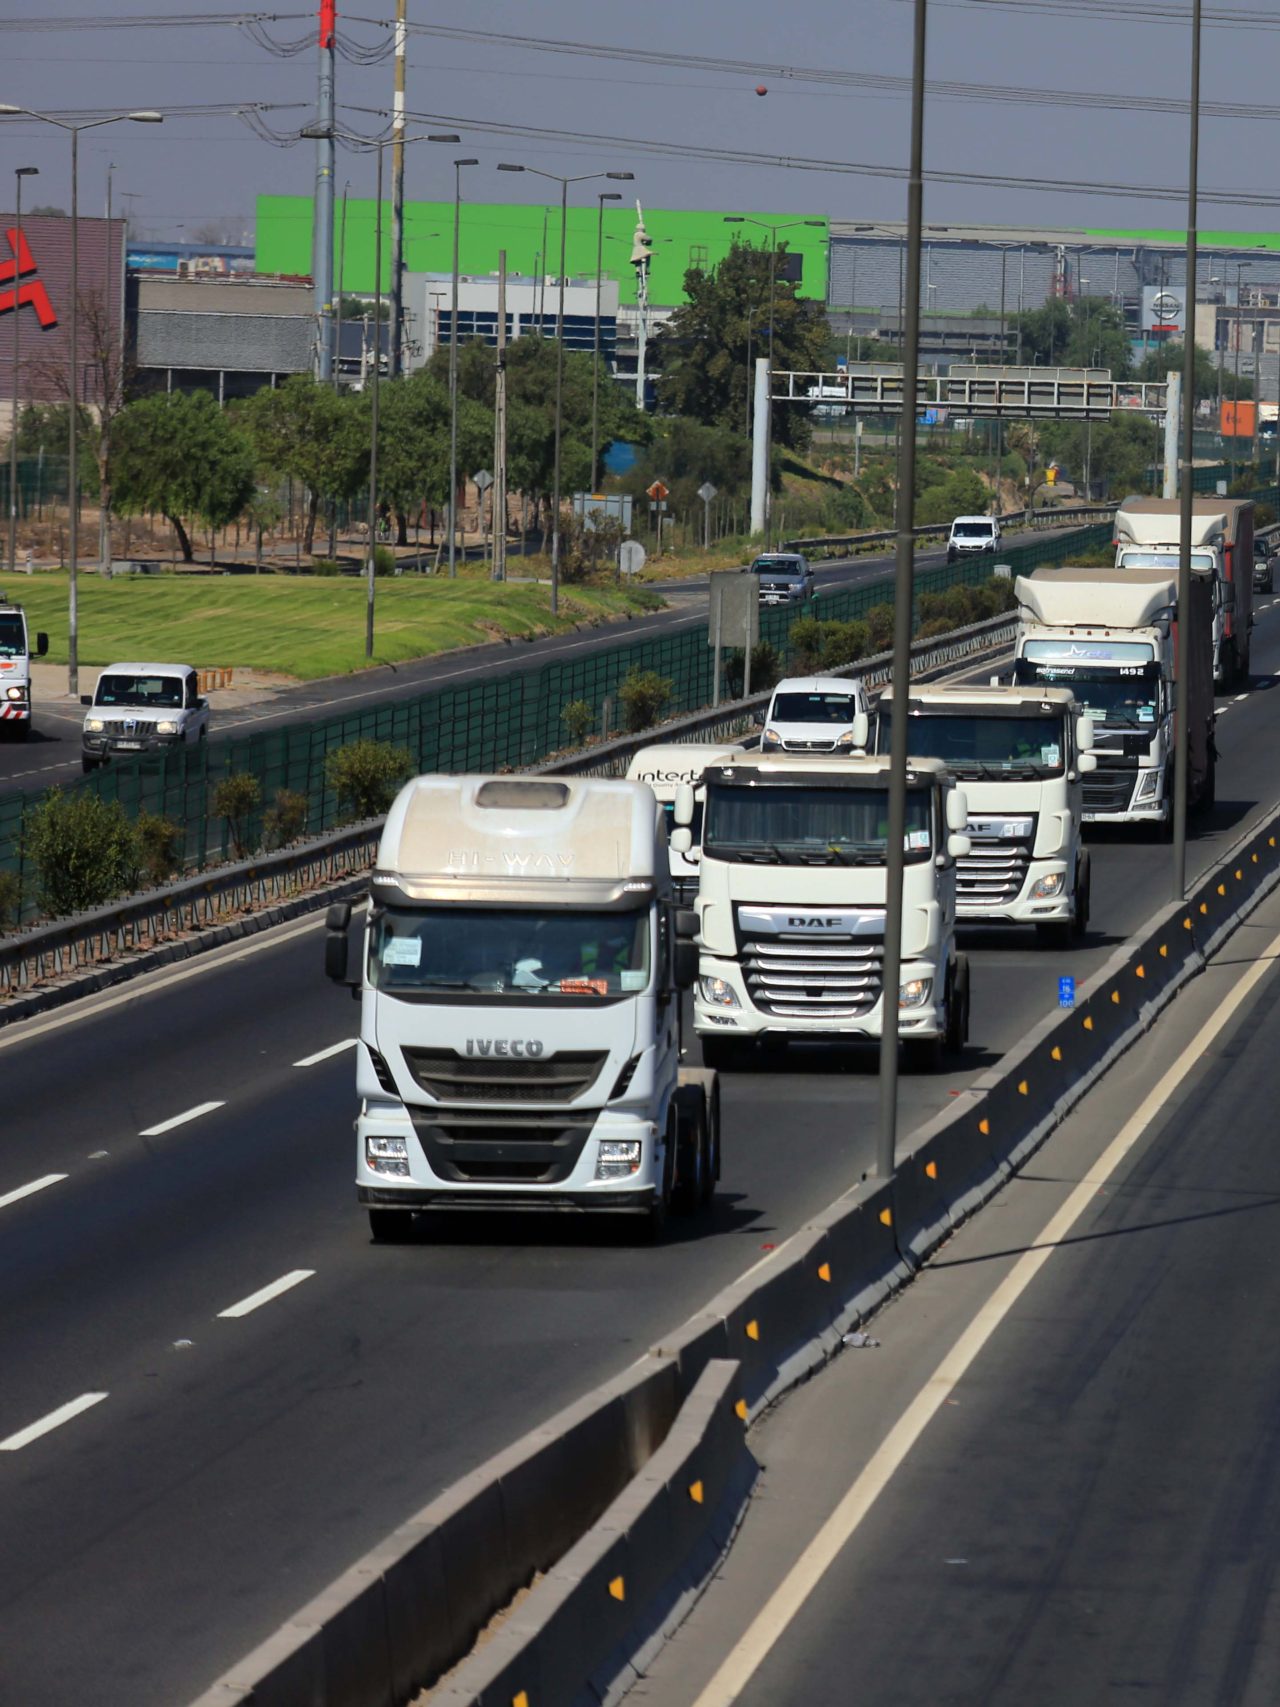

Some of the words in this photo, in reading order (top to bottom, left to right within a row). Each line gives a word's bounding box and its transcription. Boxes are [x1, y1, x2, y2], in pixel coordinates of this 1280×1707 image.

[1119, 668, 1145, 676] 1492
[964, 824, 992, 832] AF
[788, 917, 843, 928] DAF
[466, 1038, 544, 1057] IVECO
